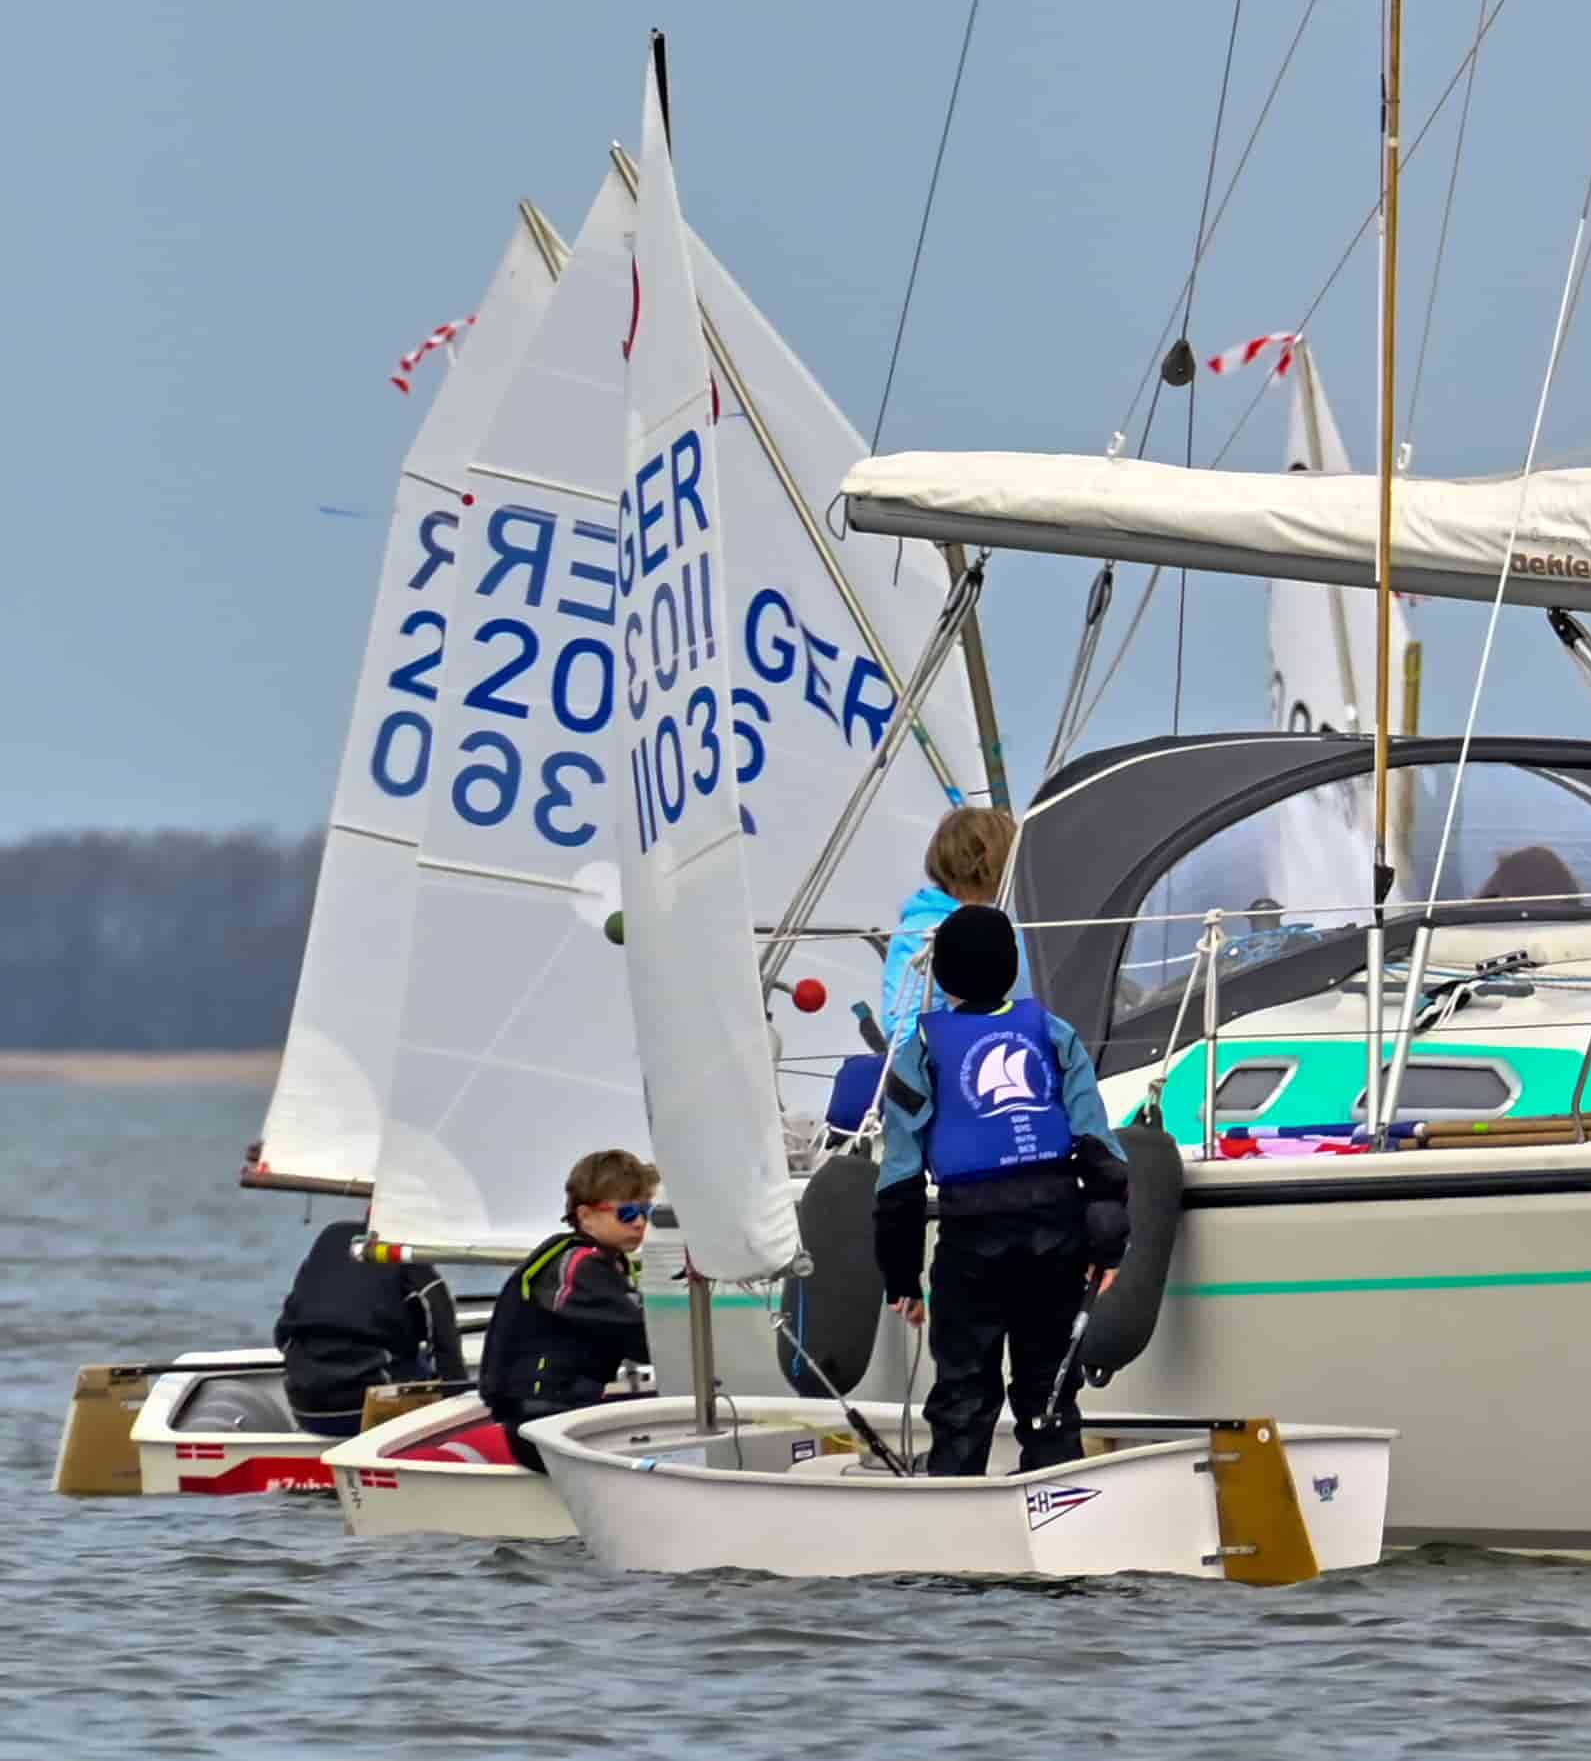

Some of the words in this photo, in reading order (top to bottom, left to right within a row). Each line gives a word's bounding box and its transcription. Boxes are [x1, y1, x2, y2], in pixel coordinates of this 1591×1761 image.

[617, 430, 709, 597] GER
[745, 589, 900, 768] GER
[631, 686, 721, 855] 1103
